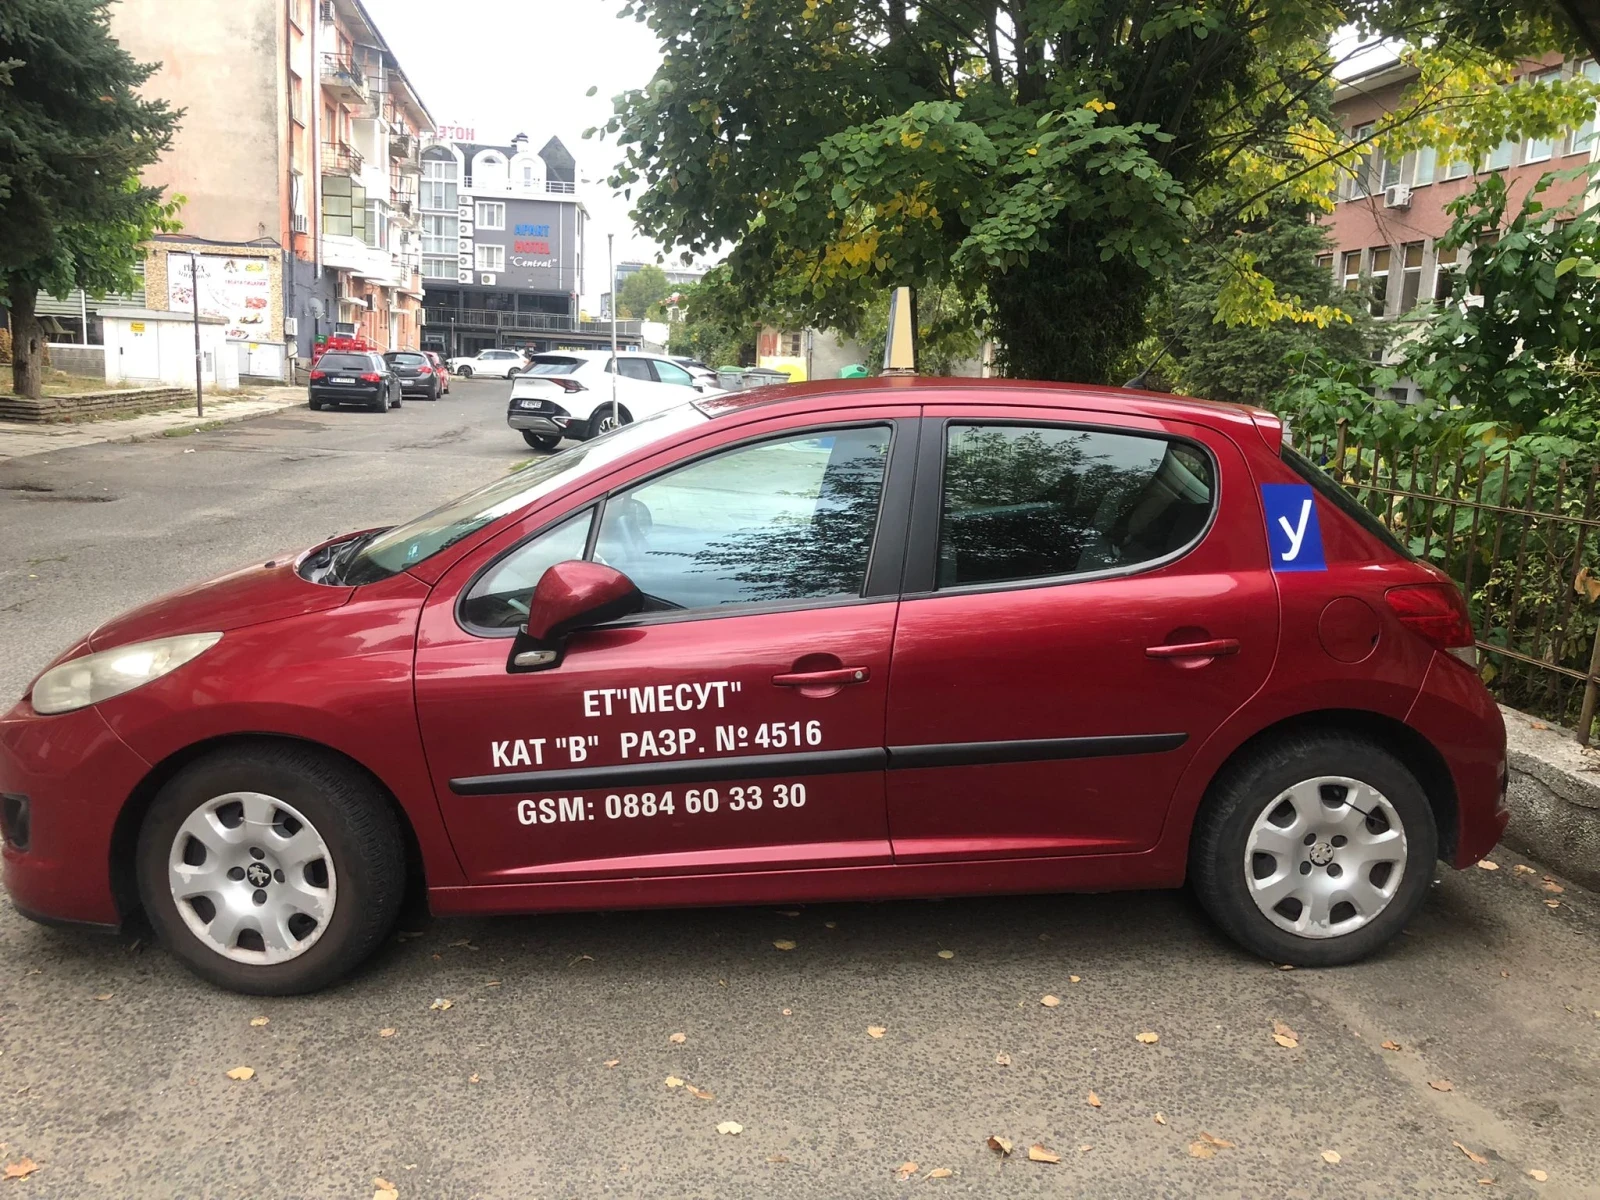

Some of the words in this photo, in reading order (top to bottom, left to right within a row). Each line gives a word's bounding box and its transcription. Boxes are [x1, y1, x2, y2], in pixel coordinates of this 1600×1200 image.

[514, 224, 550, 237] APART
[514, 240, 550, 255] HOTEL
[491, 738, 547, 768] КАТ
[620, 727, 705, 759] РАЗР.
[517, 796, 595, 826] GSM:
[605, 790, 676, 820] 0884
[685, 788, 719, 814] 60
[729, 785, 763, 811] 33
[772, 783, 807, 809] 30
